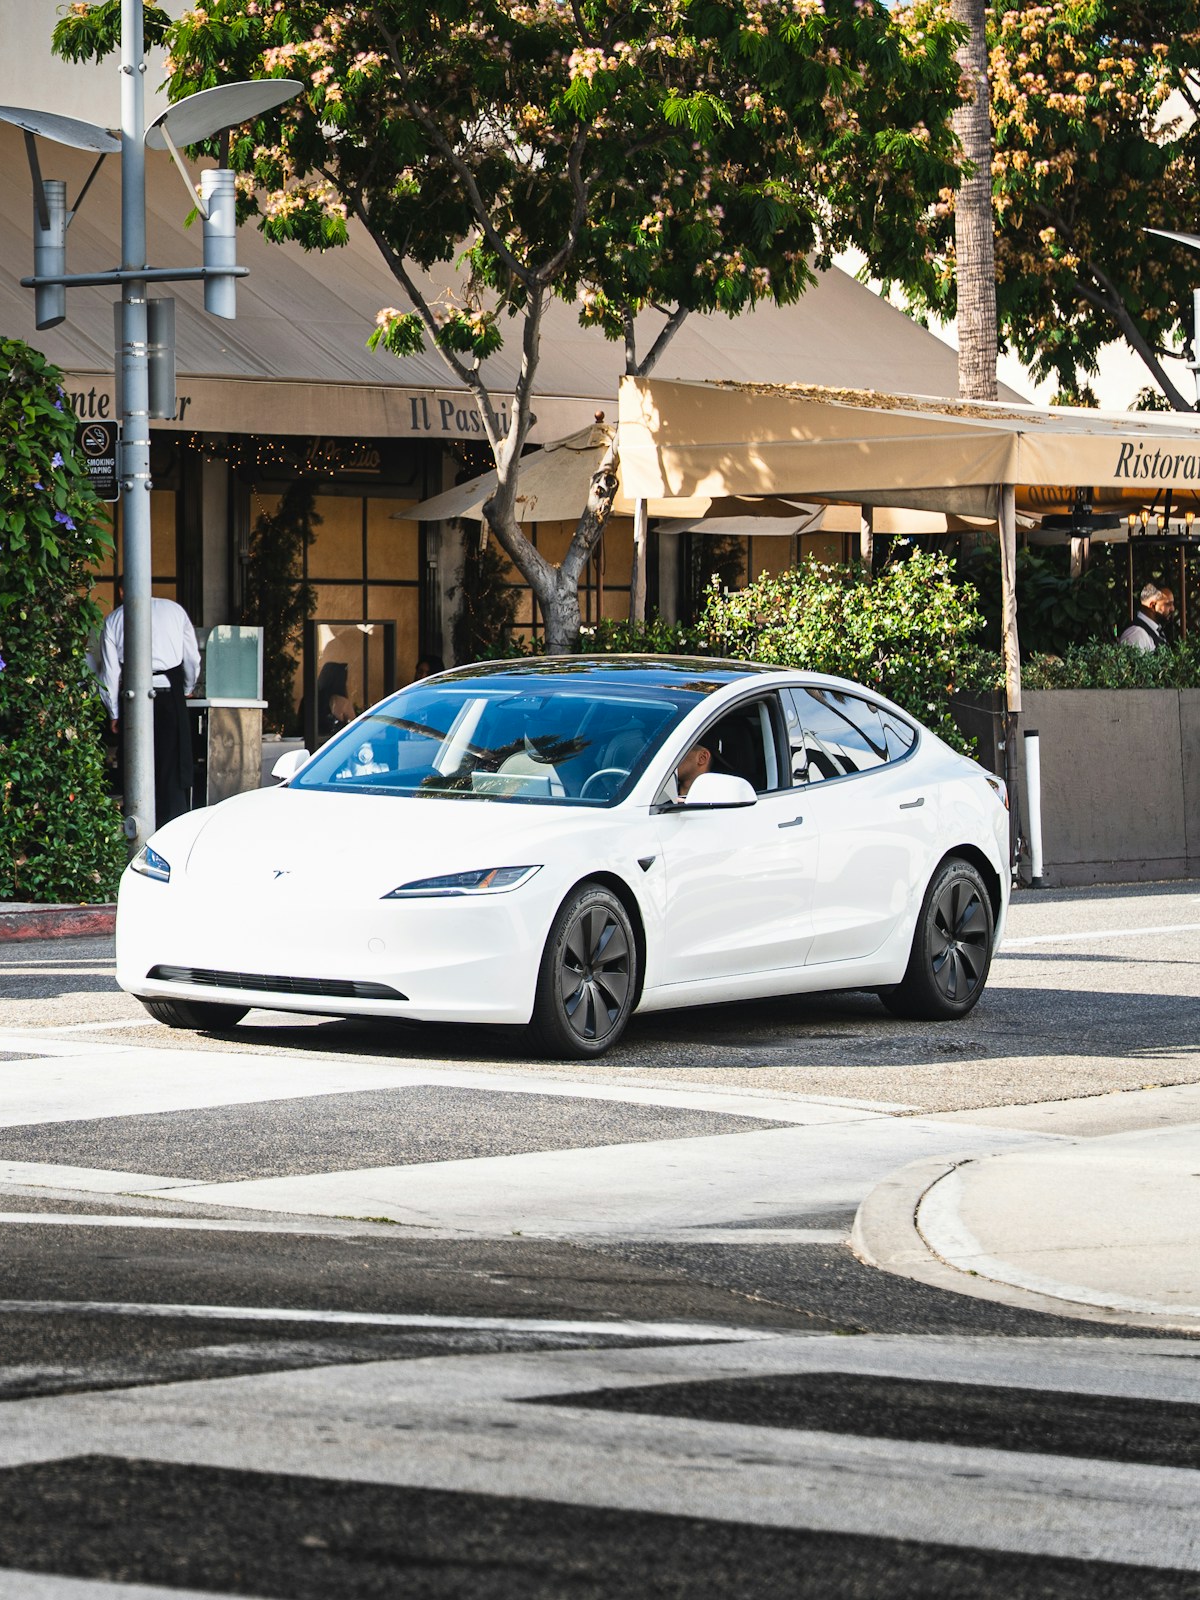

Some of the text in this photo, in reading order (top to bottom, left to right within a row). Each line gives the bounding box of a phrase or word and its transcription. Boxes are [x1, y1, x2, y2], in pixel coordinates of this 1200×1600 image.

[408, 397, 513, 435] Il Pasi
[86, 458, 115, 467] SMOKING
[89, 466, 112, 474] VAPING
[1113, 442, 1200, 480] Ristora
